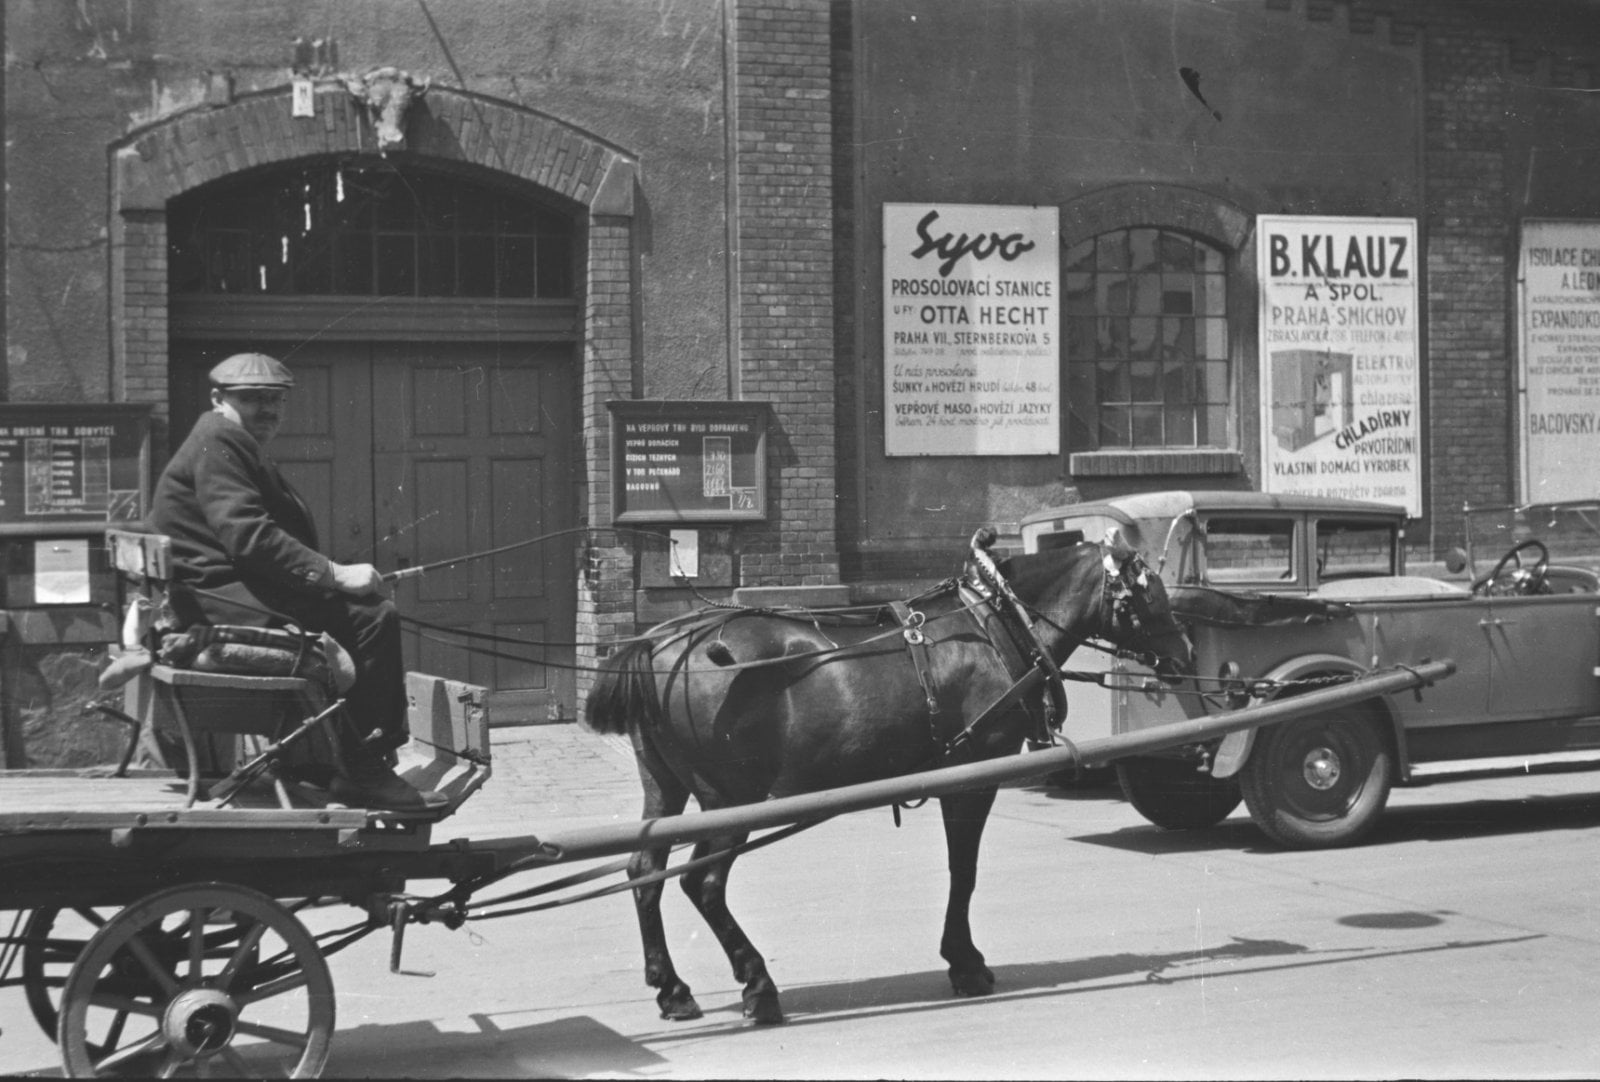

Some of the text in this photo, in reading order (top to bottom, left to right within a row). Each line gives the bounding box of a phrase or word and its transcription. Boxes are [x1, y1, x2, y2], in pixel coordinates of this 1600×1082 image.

[995, 281, 1052, 297] STANICE
[1304, 283, 1383, 302] A SPOL.
[920, 304, 970, 325] OTTA
[980, 306, 1049, 325] HECHT
[894, 331, 929, 345] PRAHA
[892, 379, 922, 393] ŠUNKY
[895, 400, 939, 415] VEPŘOVÉ
[944, 403, 972, 415] MASO
[1017, 403, 1053, 415] JAZYKY
[1335, 409, 1411, 450] CHLADÍRNY
